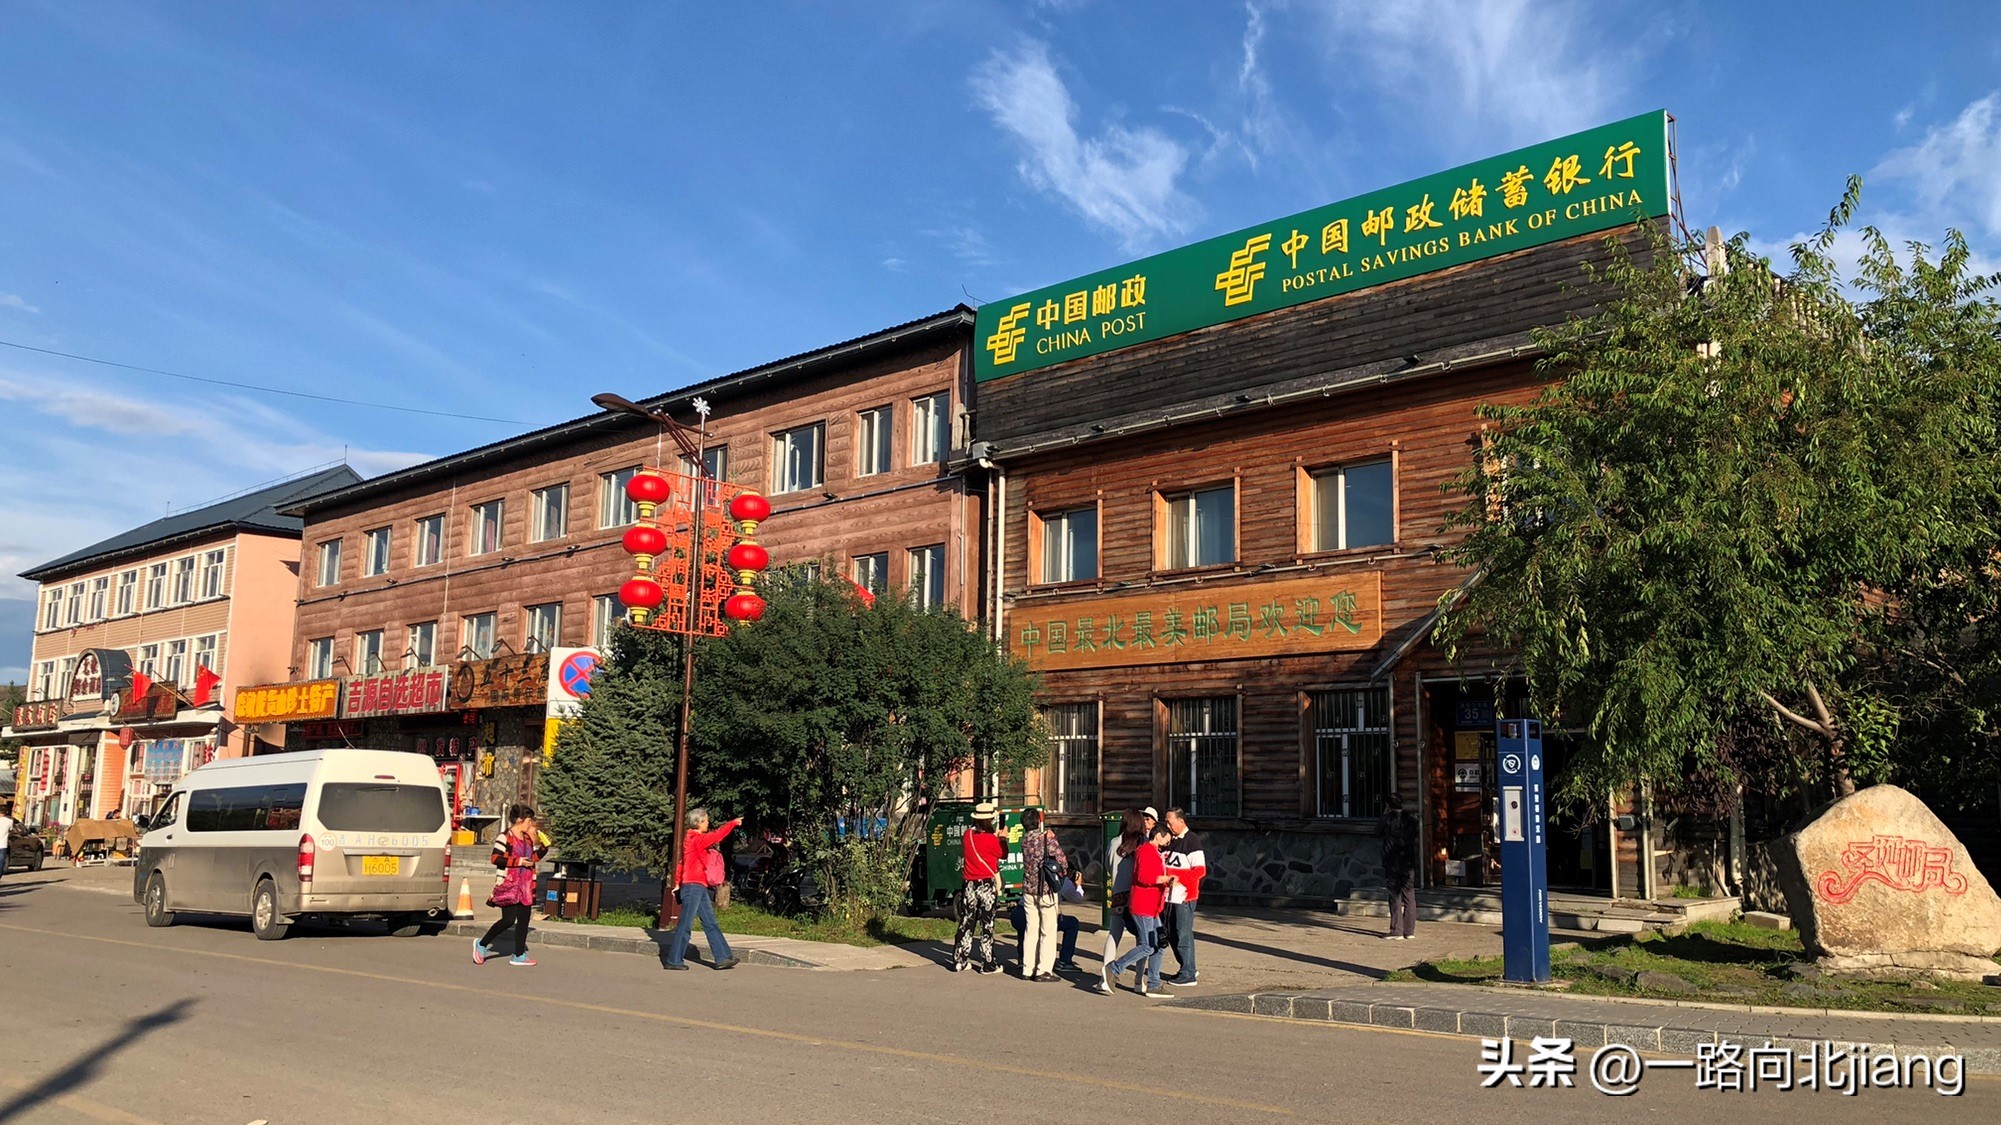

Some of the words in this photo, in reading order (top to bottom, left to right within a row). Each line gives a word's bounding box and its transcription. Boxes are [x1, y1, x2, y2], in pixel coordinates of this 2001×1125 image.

[1281, 141, 1641, 269] 中国邮政储蓄银行
[1282, 268, 1354, 292] POSTAL
[1361, 237, 1449, 273] SAVINGS
[1458, 218, 1519, 248] BANK
[1528, 208, 1558, 230] OF
[1566, 189, 1643, 220] CHINA
[1036, 274, 1146, 330] 中国邮政
[1037, 327, 1091, 354] CHINA
[1101, 312, 1146, 338] POST
[1020, 589, 1363, 657] 中国最北最美邮局欢迎您
[347, 671, 443, 713] 吉源自选超市
[1464, 708, 1479, 719] 35
[321, 838, 335, 847] 100
[364, 863, 398, 873] H6005
